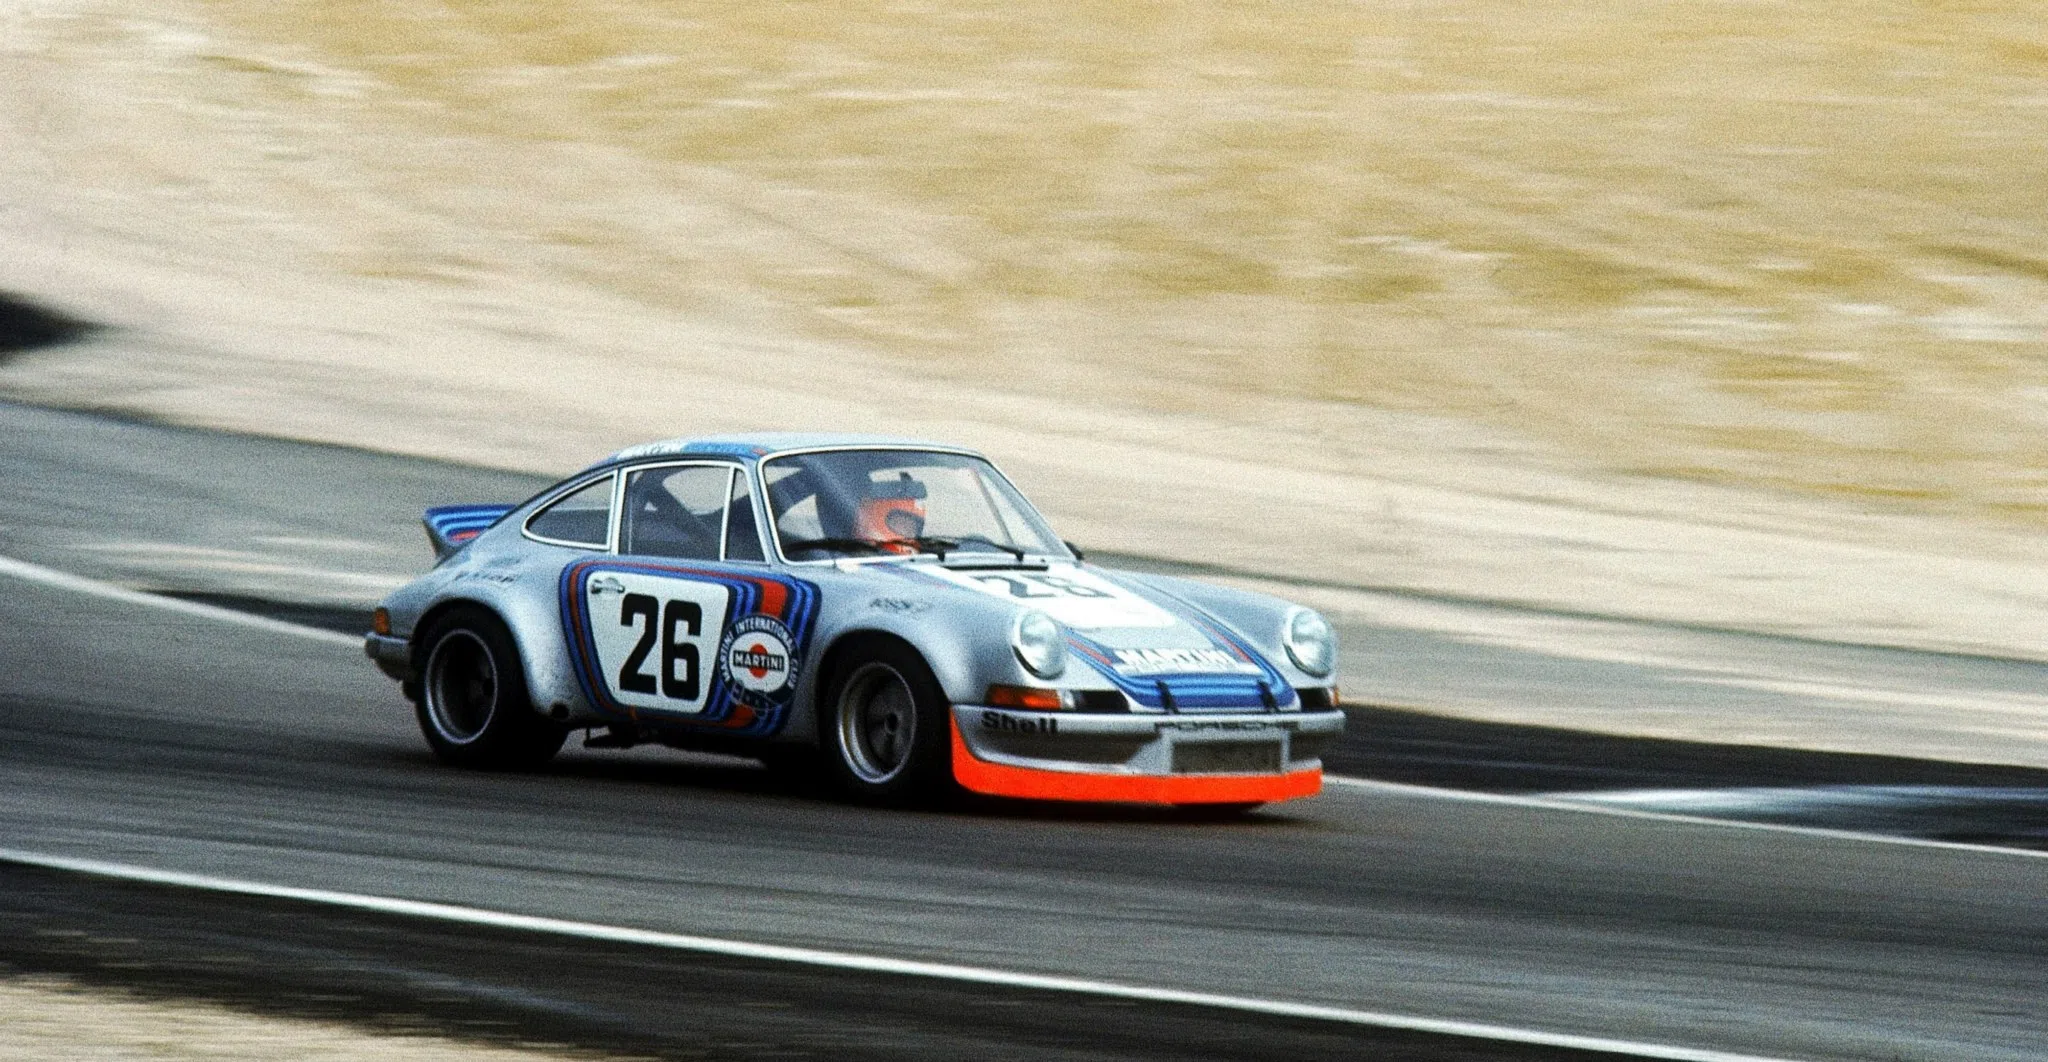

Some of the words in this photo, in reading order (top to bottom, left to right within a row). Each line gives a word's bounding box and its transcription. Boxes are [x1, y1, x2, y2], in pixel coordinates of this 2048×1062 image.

[619, 592, 702, 702] 26
[720, 630, 735, 682] MARTINI
[735, 616, 794, 655] INTERNATIONAL
[734, 652, 784, 670] MARTINI
[981, 710, 1058, 735] Shell
[1154, 721, 1299, 732] PORSCHE
